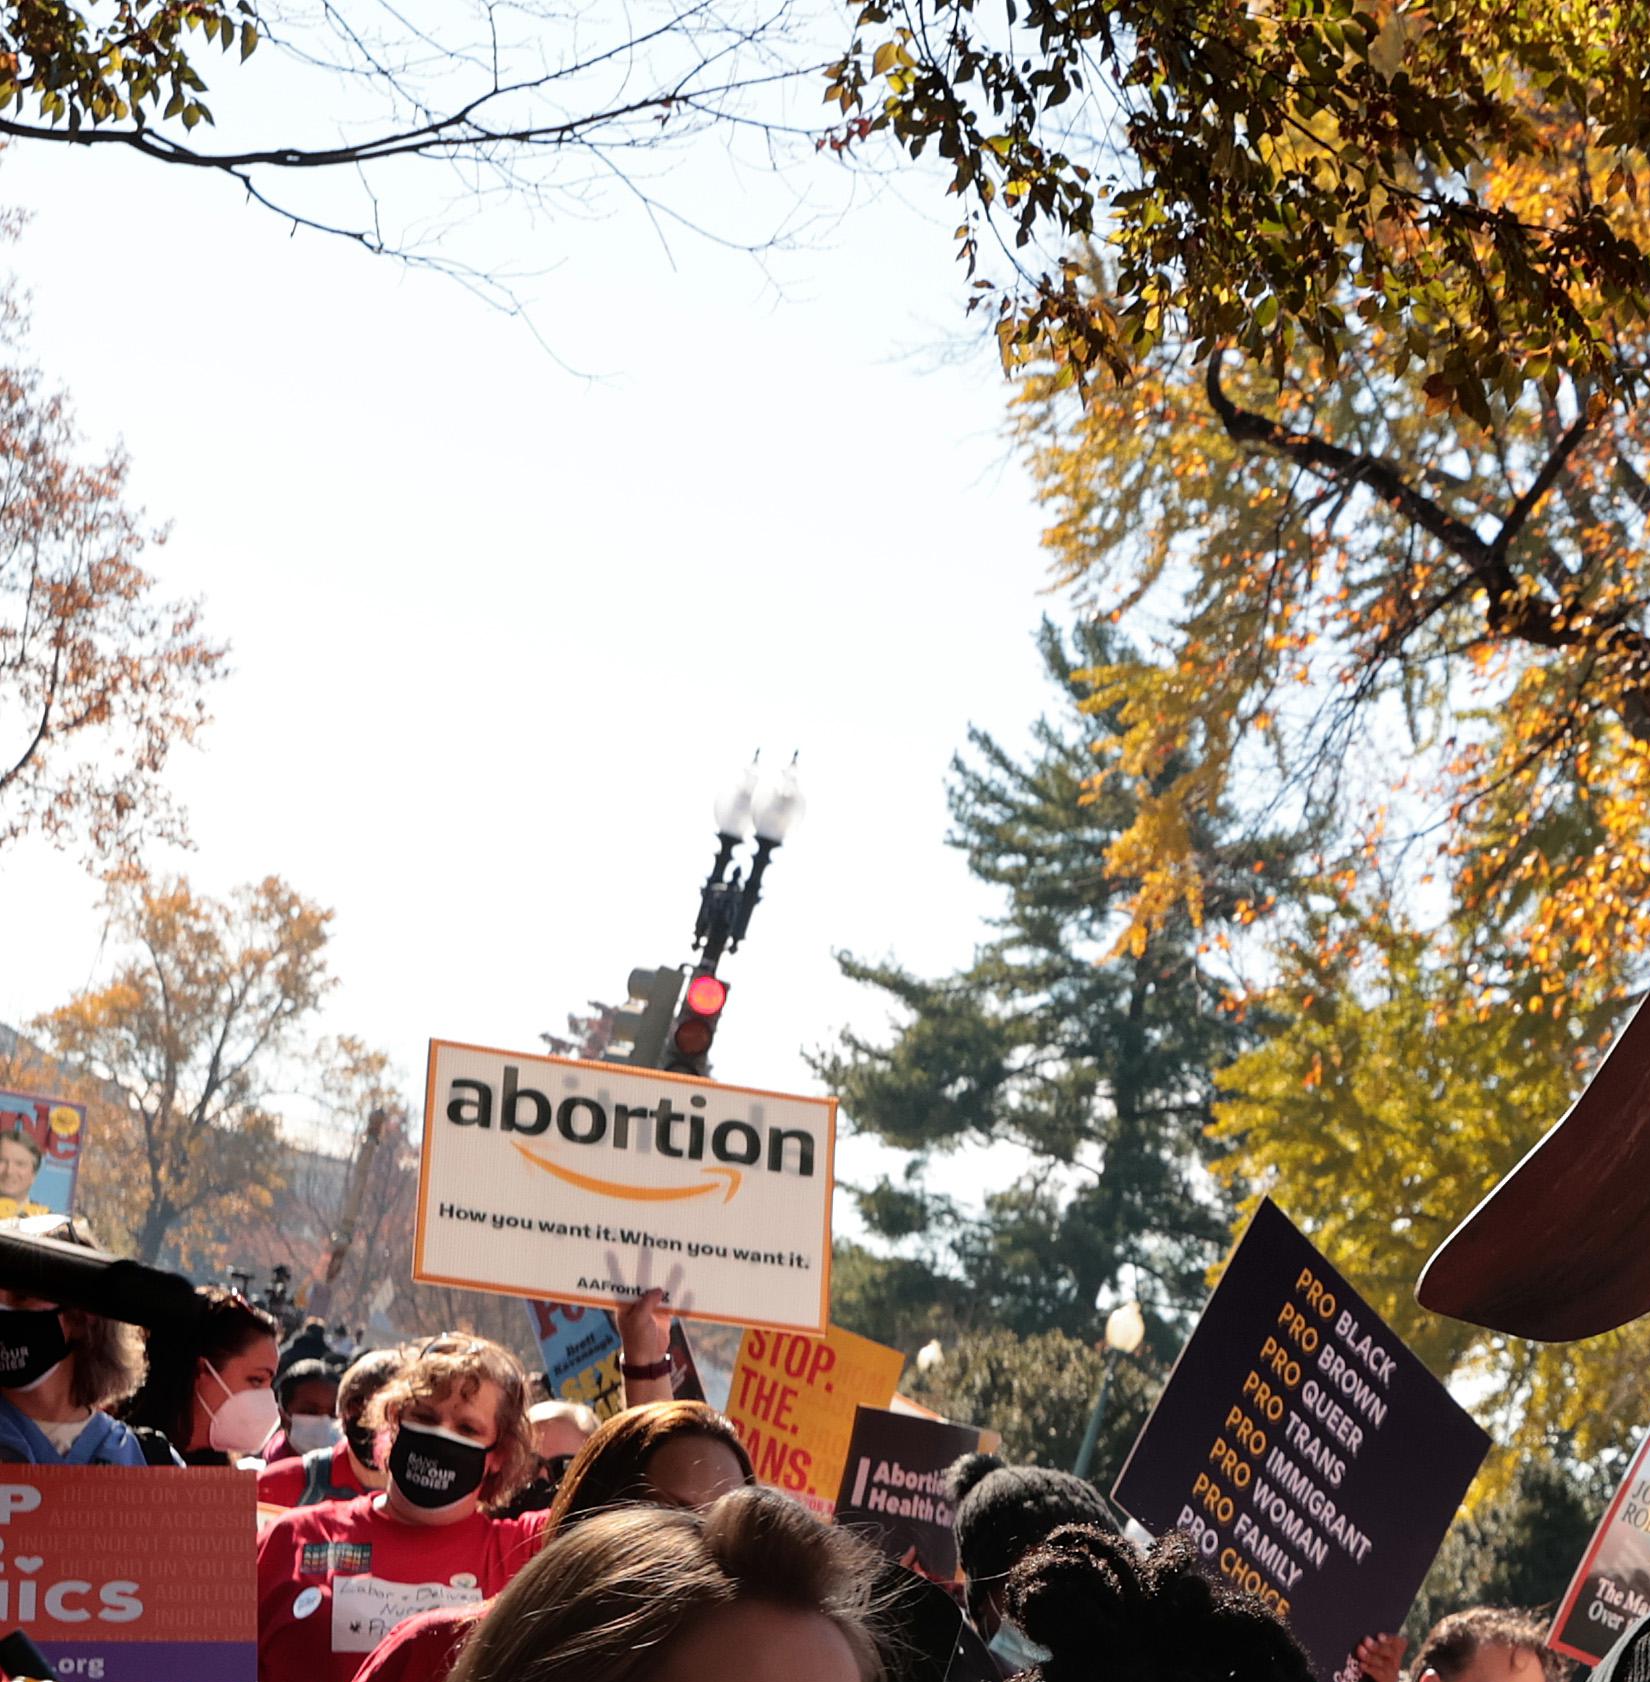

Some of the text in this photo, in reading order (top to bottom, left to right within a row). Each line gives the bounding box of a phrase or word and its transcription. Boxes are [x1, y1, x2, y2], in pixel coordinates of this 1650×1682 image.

[446, 1065, 815, 1177] abortion
[438, 1202, 811, 1271] How you want it. When you want it.
[748, 1329, 837, 1393] STOP.
[1278, 1302, 1388, 1428] PRO BROWN
[1296, 1267, 1397, 1388] PRO BLACK
[739, 1366, 801, 1435] THE.
[1243, 1371, 1346, 1487] PRO TRANS
[1260, 1336, 1364, 1456] PRO QUEER
[428, 1468, 456, 1483] OUR
[868, 1487, 934, 1522] Health
[1209, 1437, 1329, 1570] PRO WOMAN
[1225, 1405, 1372, 1564] PRO IMMIGRANT
[1177, 1504, 1291, 1617] PRO CHOICE
[1192, 1472, 1304, 1592] PRO FAMILY
[1588, 1600, 1624, 1631] Over
[1595, 1577, 1624, 1606] The
